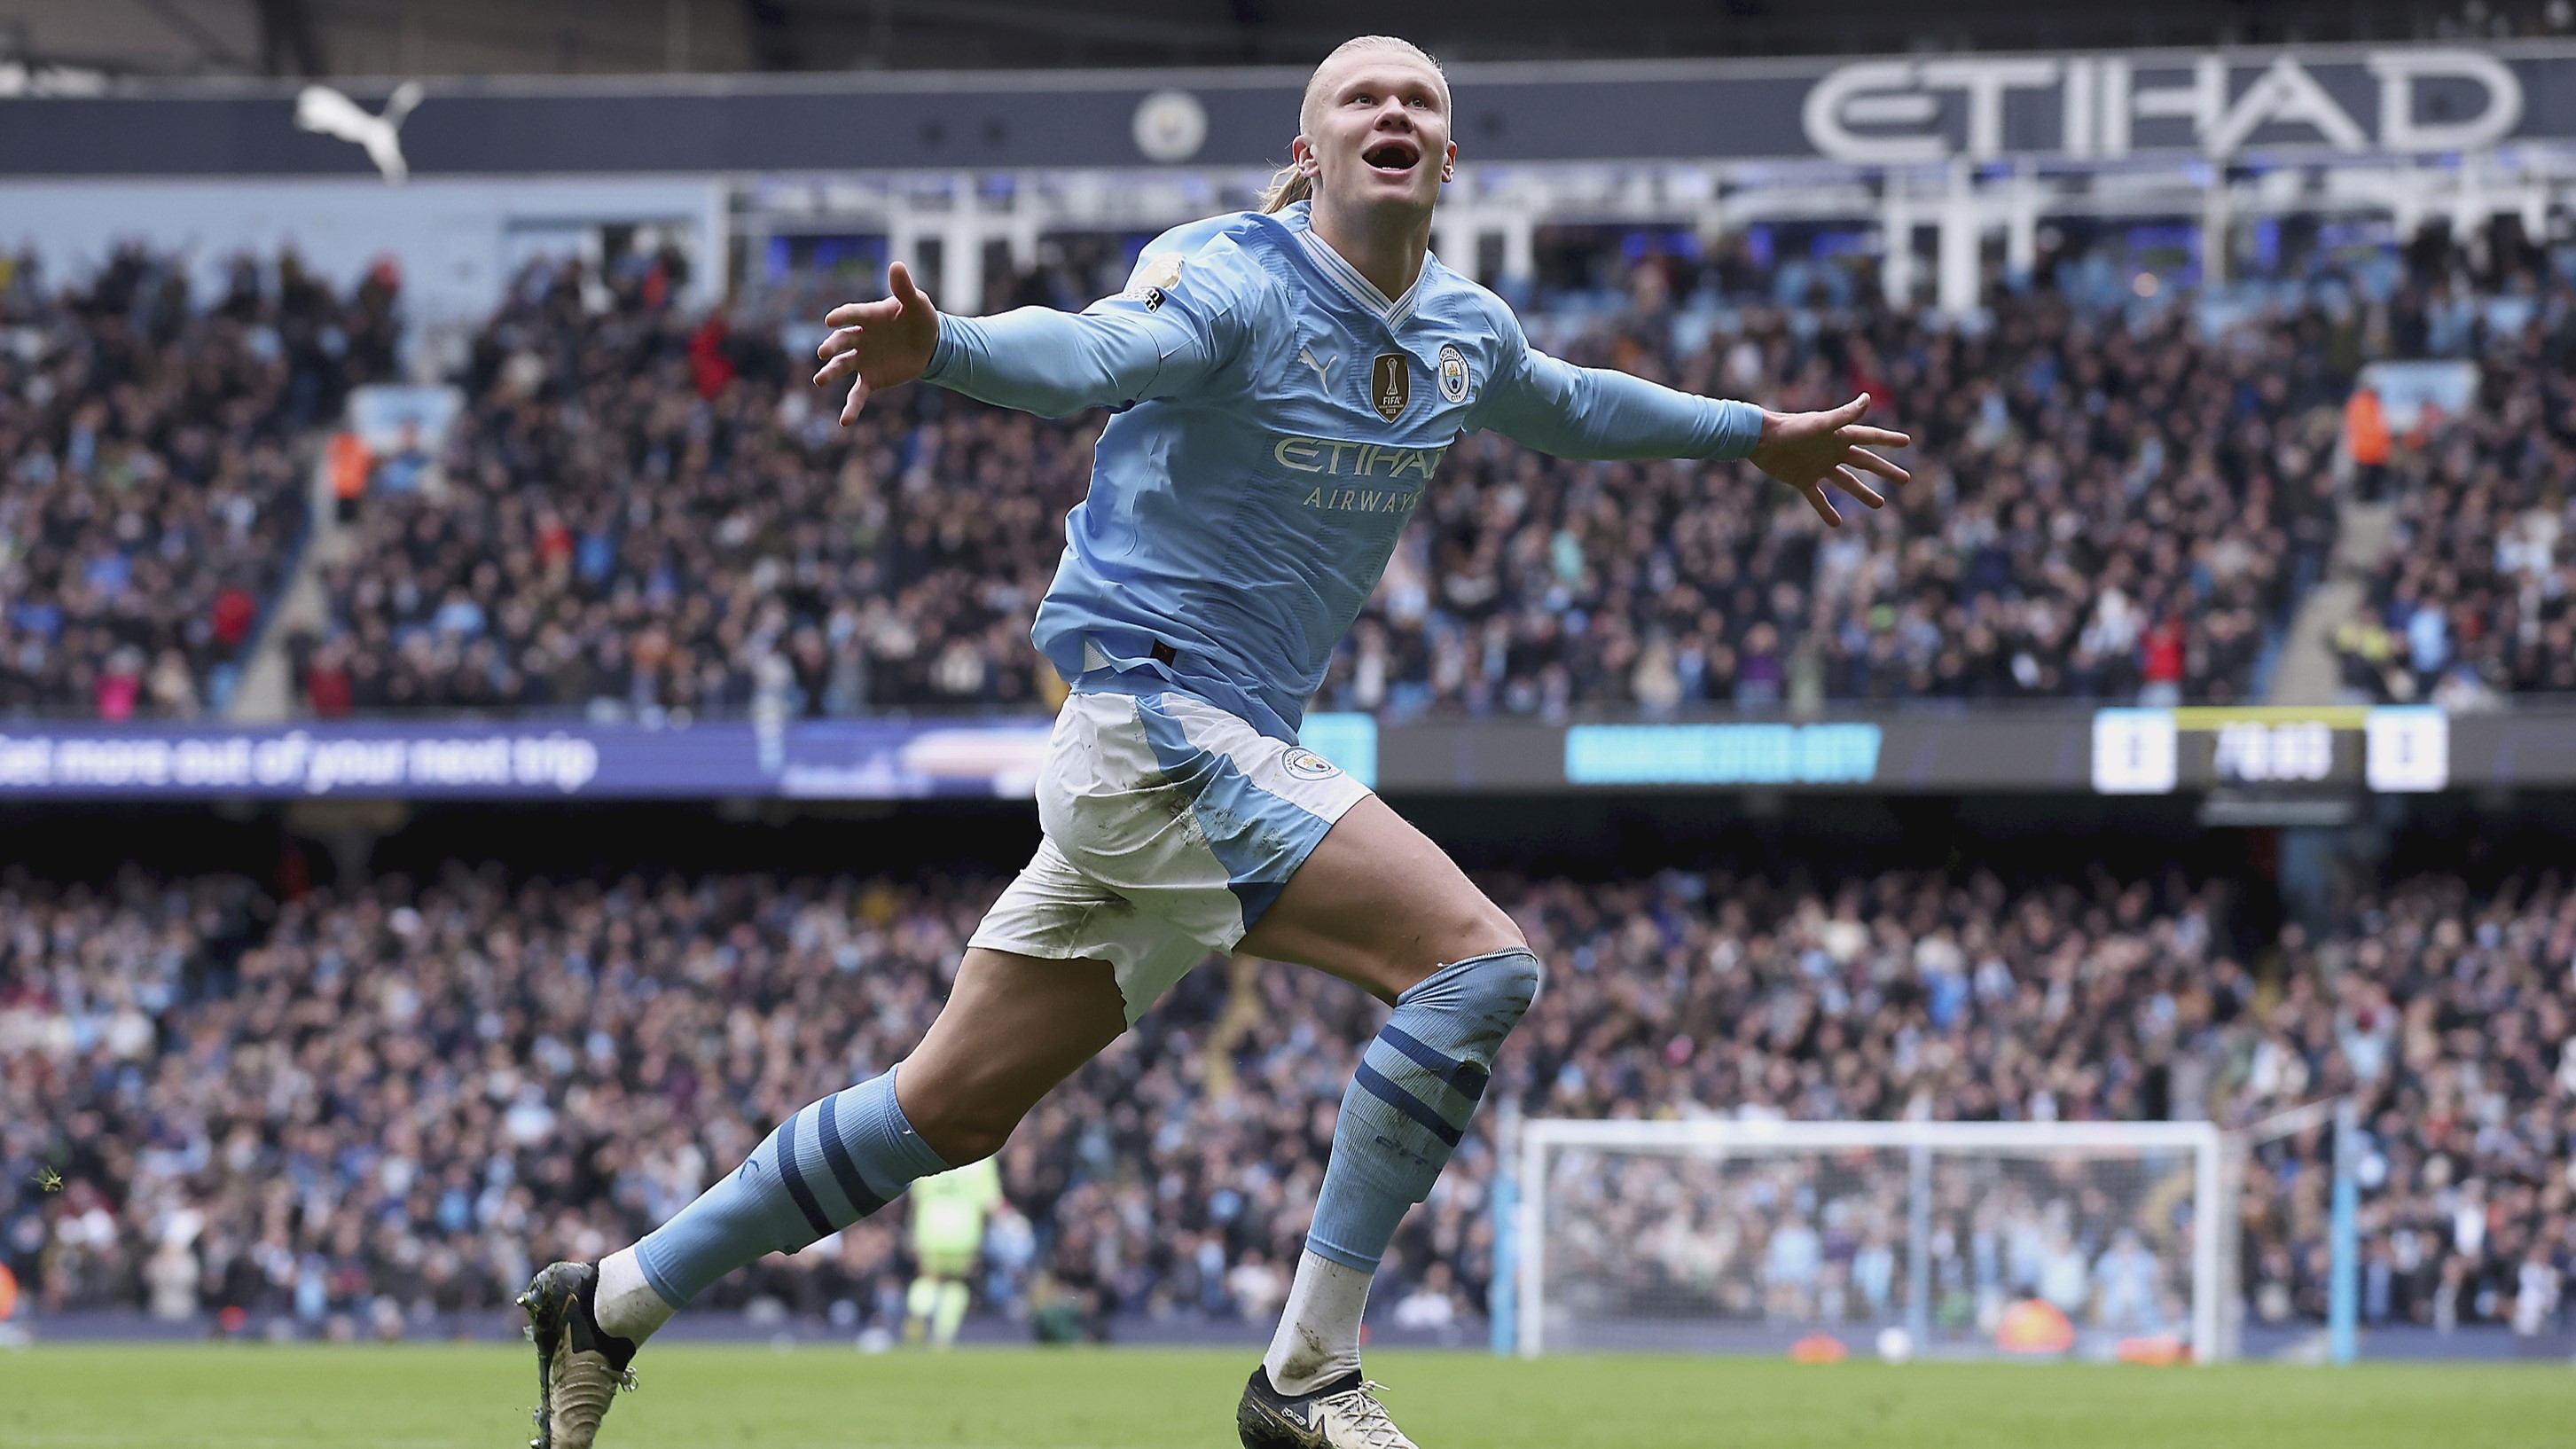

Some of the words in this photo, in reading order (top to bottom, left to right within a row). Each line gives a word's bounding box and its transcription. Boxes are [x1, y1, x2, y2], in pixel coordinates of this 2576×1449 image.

[1801, 51, 2525, 164] ETIHAD
[1382, 396, 1401, 405] FIFA
[58, 737, 172, 786] more
[176, 735, 252, 786] out
[254, 730, 309, 786] of
[309, 737, 405, 795] your
[410, 735, 509, 786] next
[514, 731, 597, 794] trip
